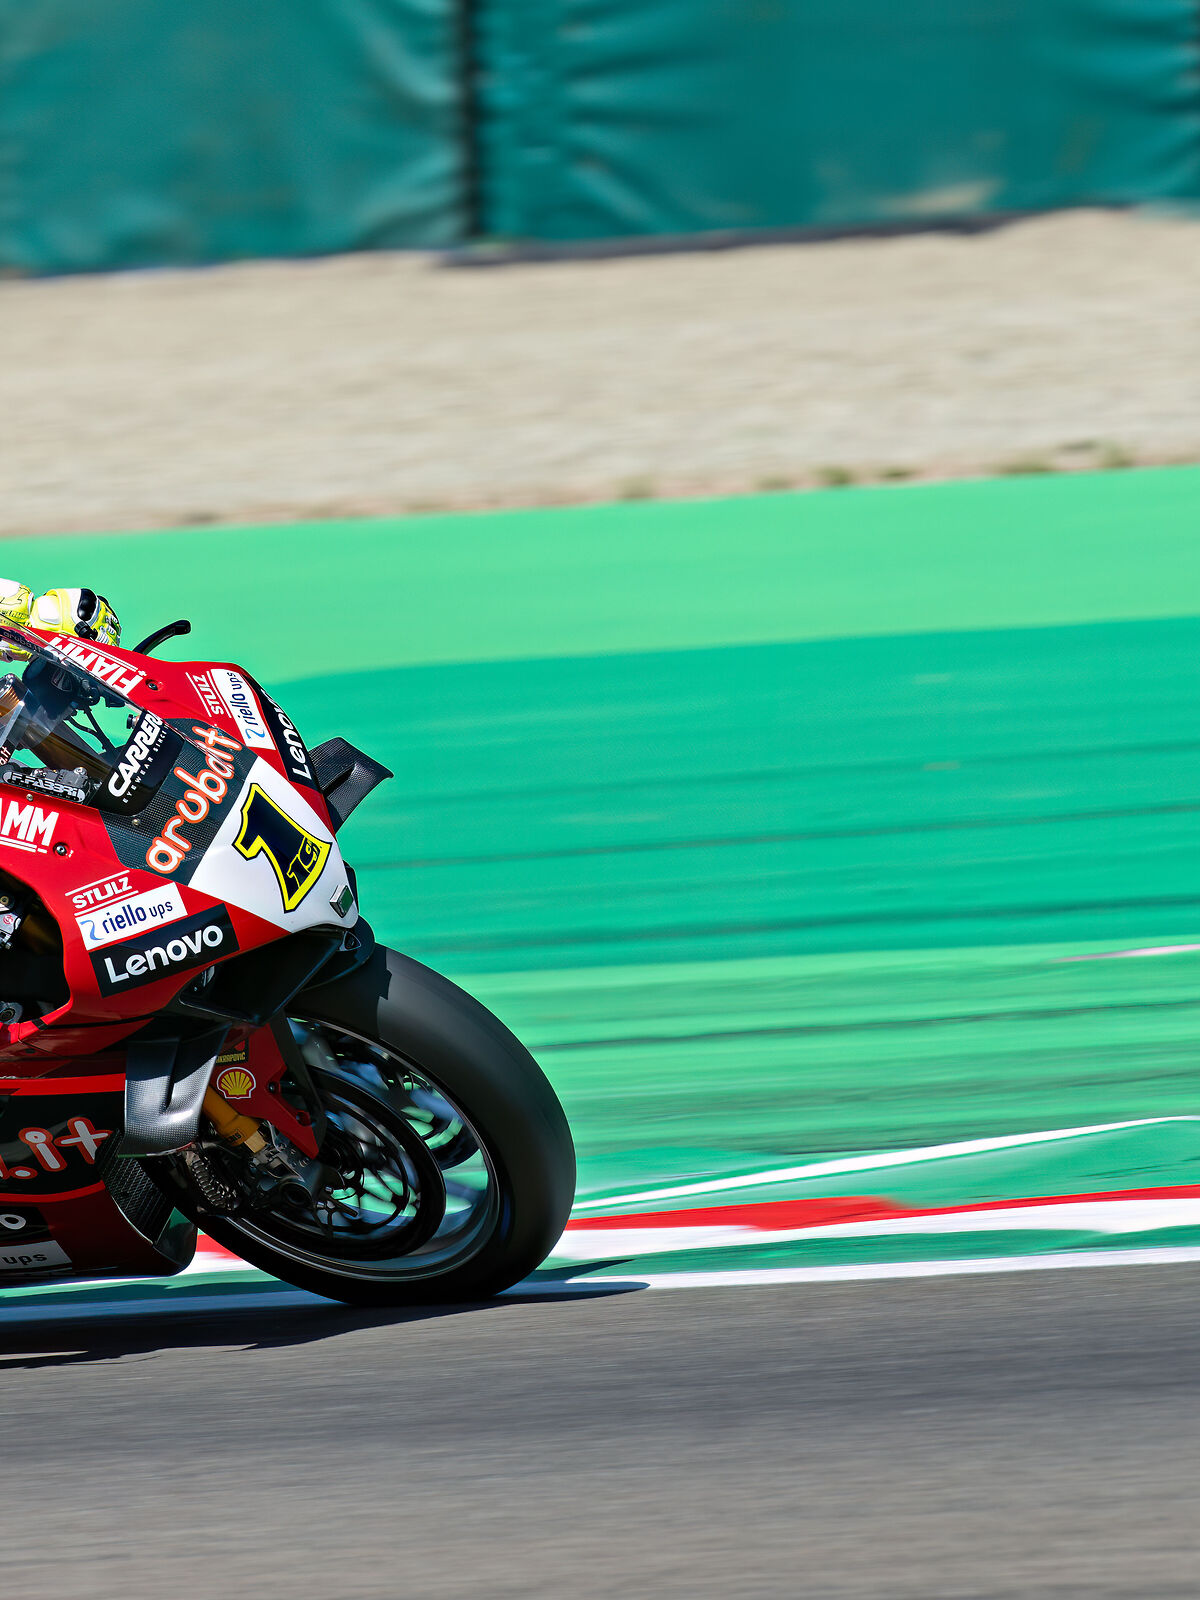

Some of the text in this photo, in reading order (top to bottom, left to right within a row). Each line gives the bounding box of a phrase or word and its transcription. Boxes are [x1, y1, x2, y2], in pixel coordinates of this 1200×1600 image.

[192, 674, 225, 715] STULZ
[226, 672, 259, 726] riello ups
[122, 756, 153, 804] EYEWEAR
[231, 783, 333, 914] 1
[72, 877, 132, 909] STULZ
[102, 901, 173, 934] riello ups
[103, 925, 224, 983] Lenovo
[2, 1251, 47, 1267] ups
